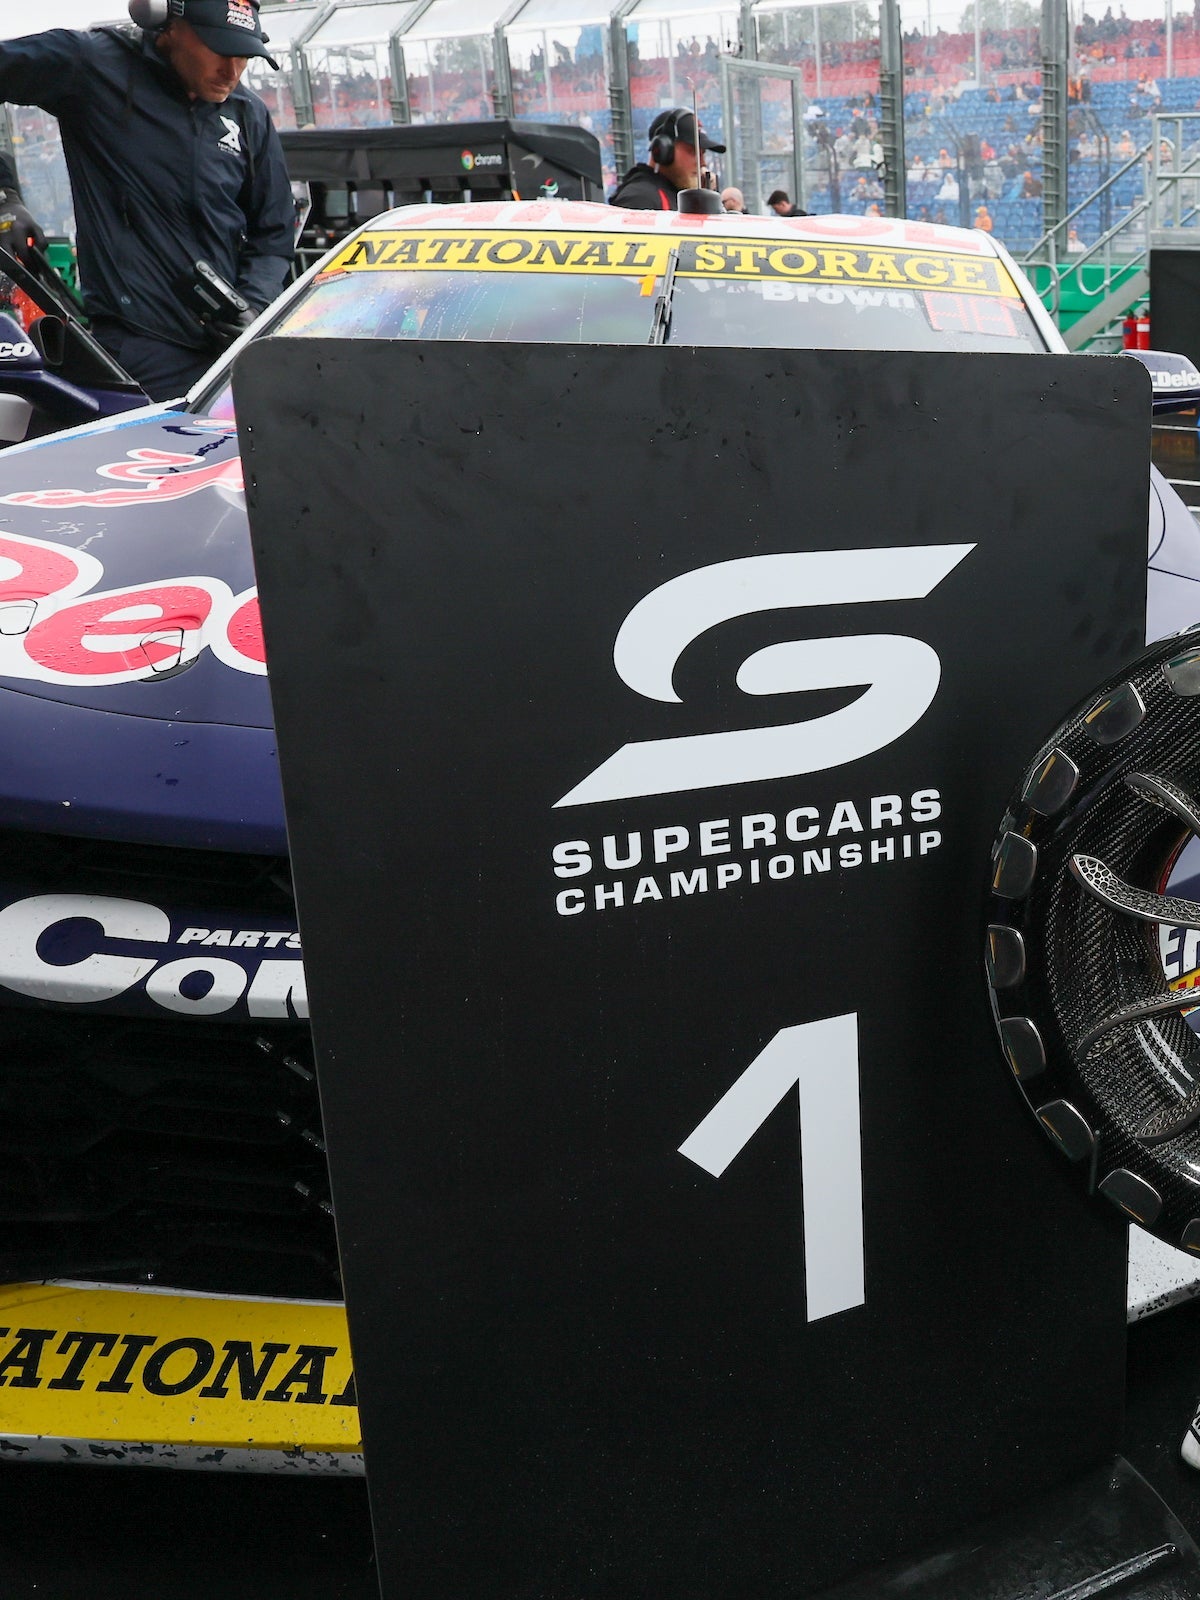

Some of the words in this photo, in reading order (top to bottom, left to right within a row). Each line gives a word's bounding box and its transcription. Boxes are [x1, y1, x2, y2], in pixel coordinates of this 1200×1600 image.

[342, 239, 656, 267] NATIONAL
[695, 244, 987, 290] STORAGE
[551, 788, 942, 879] SUPERCARS
[555, 830, 942, 917] CHAMPIONSHIP
[678, 1012, 866, 1323] 1
[0, 1328, 358, 1406] ATIONA
